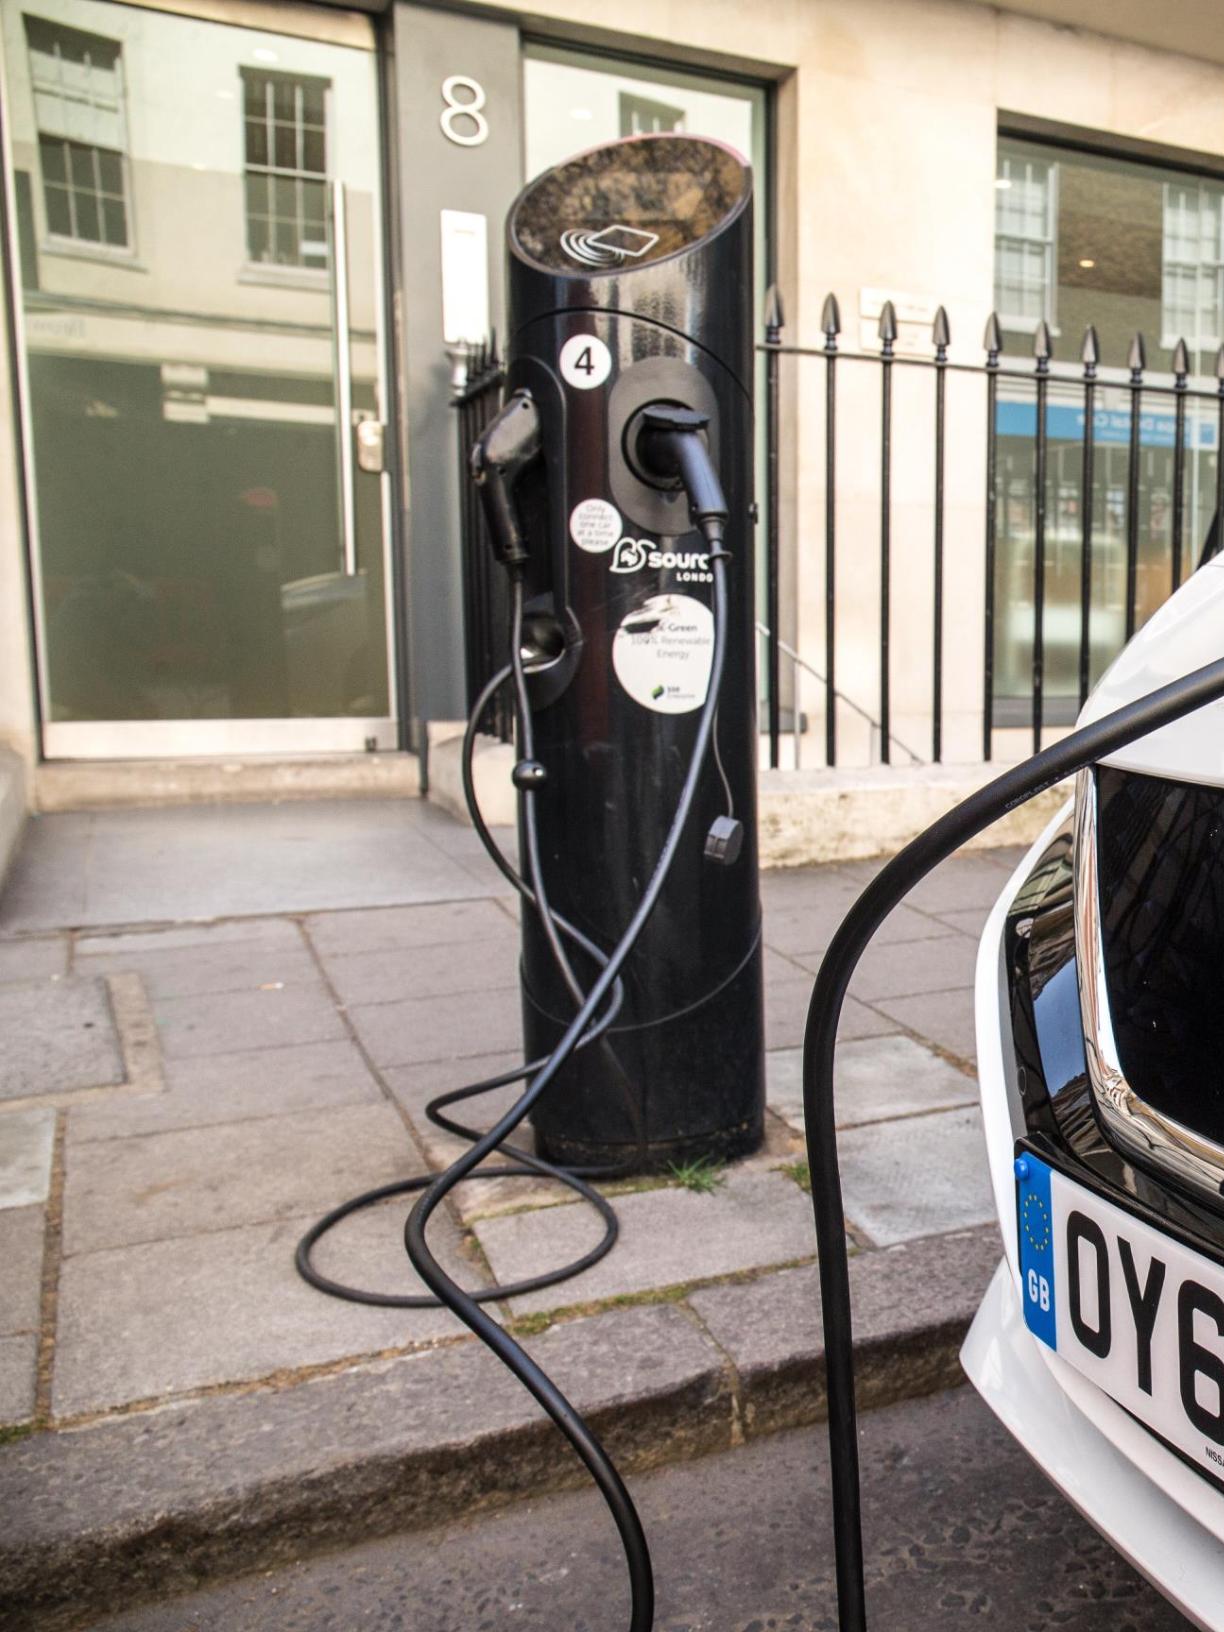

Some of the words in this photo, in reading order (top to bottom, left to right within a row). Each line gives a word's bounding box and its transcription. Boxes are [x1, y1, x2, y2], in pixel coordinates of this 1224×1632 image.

[440, 75, 489, 146] 8
[574, 346, 595, 376] 4
[648, 552, 711, 570] sourc
[676, 572, 714, 583] LONDO
[668, 623, 698, 632] Green
[656, 649, 690, 661] Energy
[1028, 1268, 1051, 1313] GB
